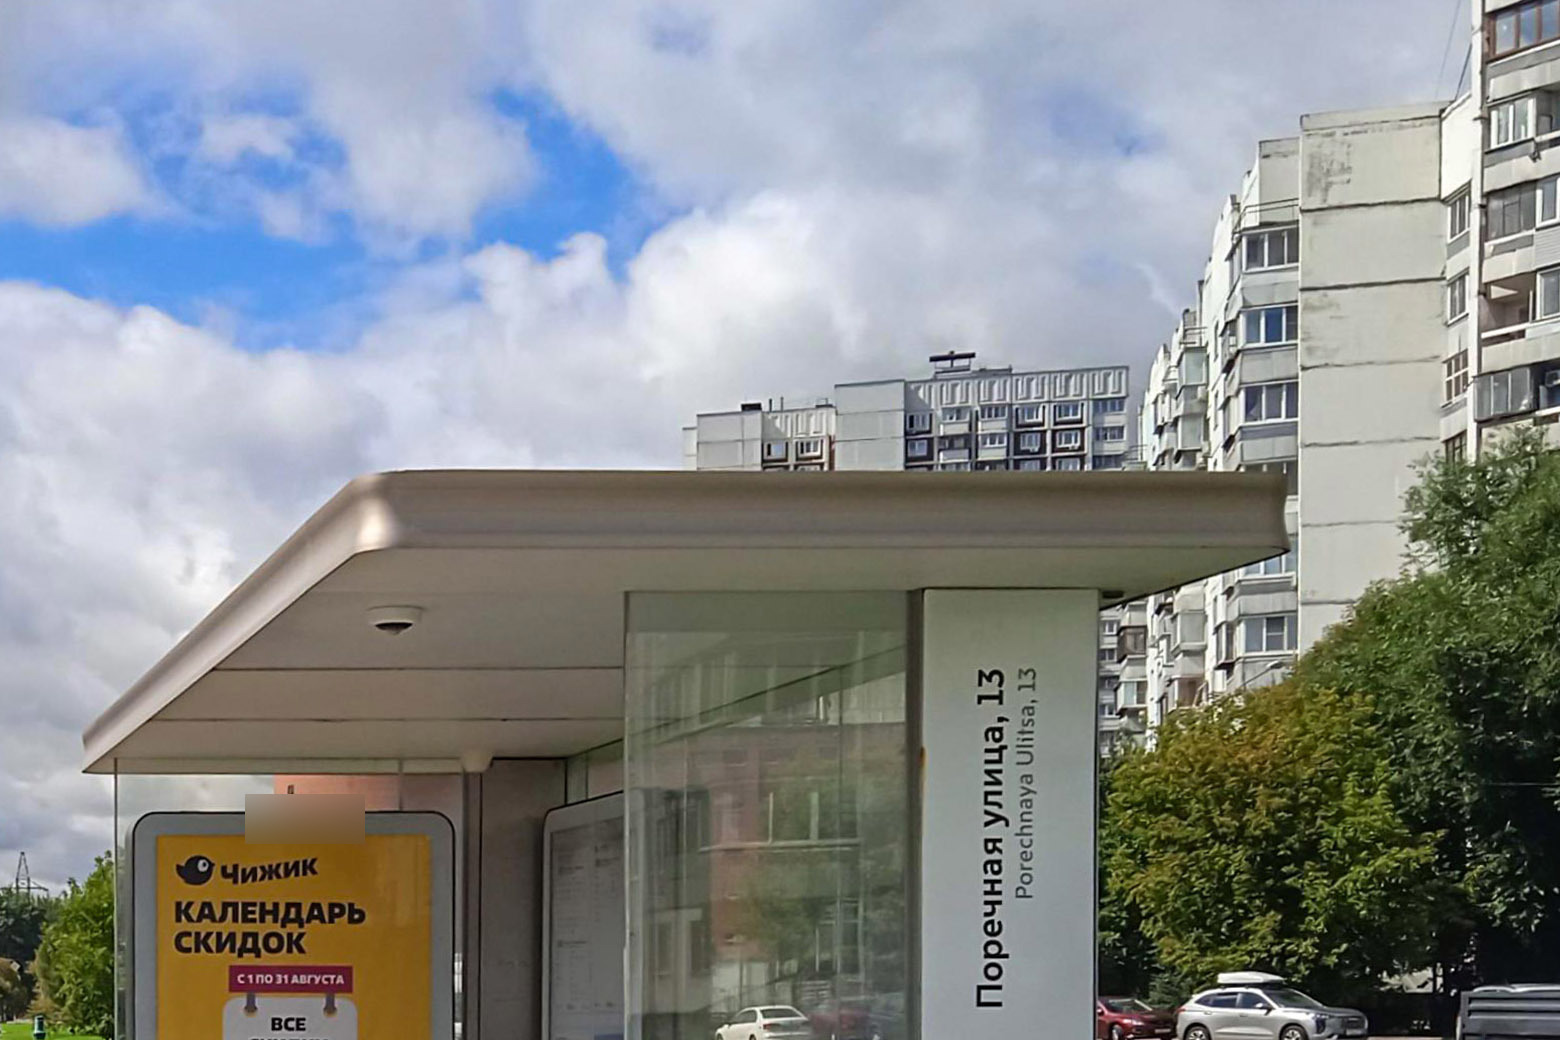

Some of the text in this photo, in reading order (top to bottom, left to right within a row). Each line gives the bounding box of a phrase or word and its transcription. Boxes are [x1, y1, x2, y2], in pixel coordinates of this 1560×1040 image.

[1014, 667, 1039, 899] Porechnaya Ulitsa, 13
[976, 668, 1010, 1008] Поречная улица, 13
[220, 857, 319, 885] Чижик
[174, 901, 366, 929] КАЛЕНДАРЬ
[174, 931, 307, 958] СКИДОК
[237, 974, 345, 985] С 1 ПО 31 АВГУСТА
[270, 1017, 307, 1031] ВСЕ
